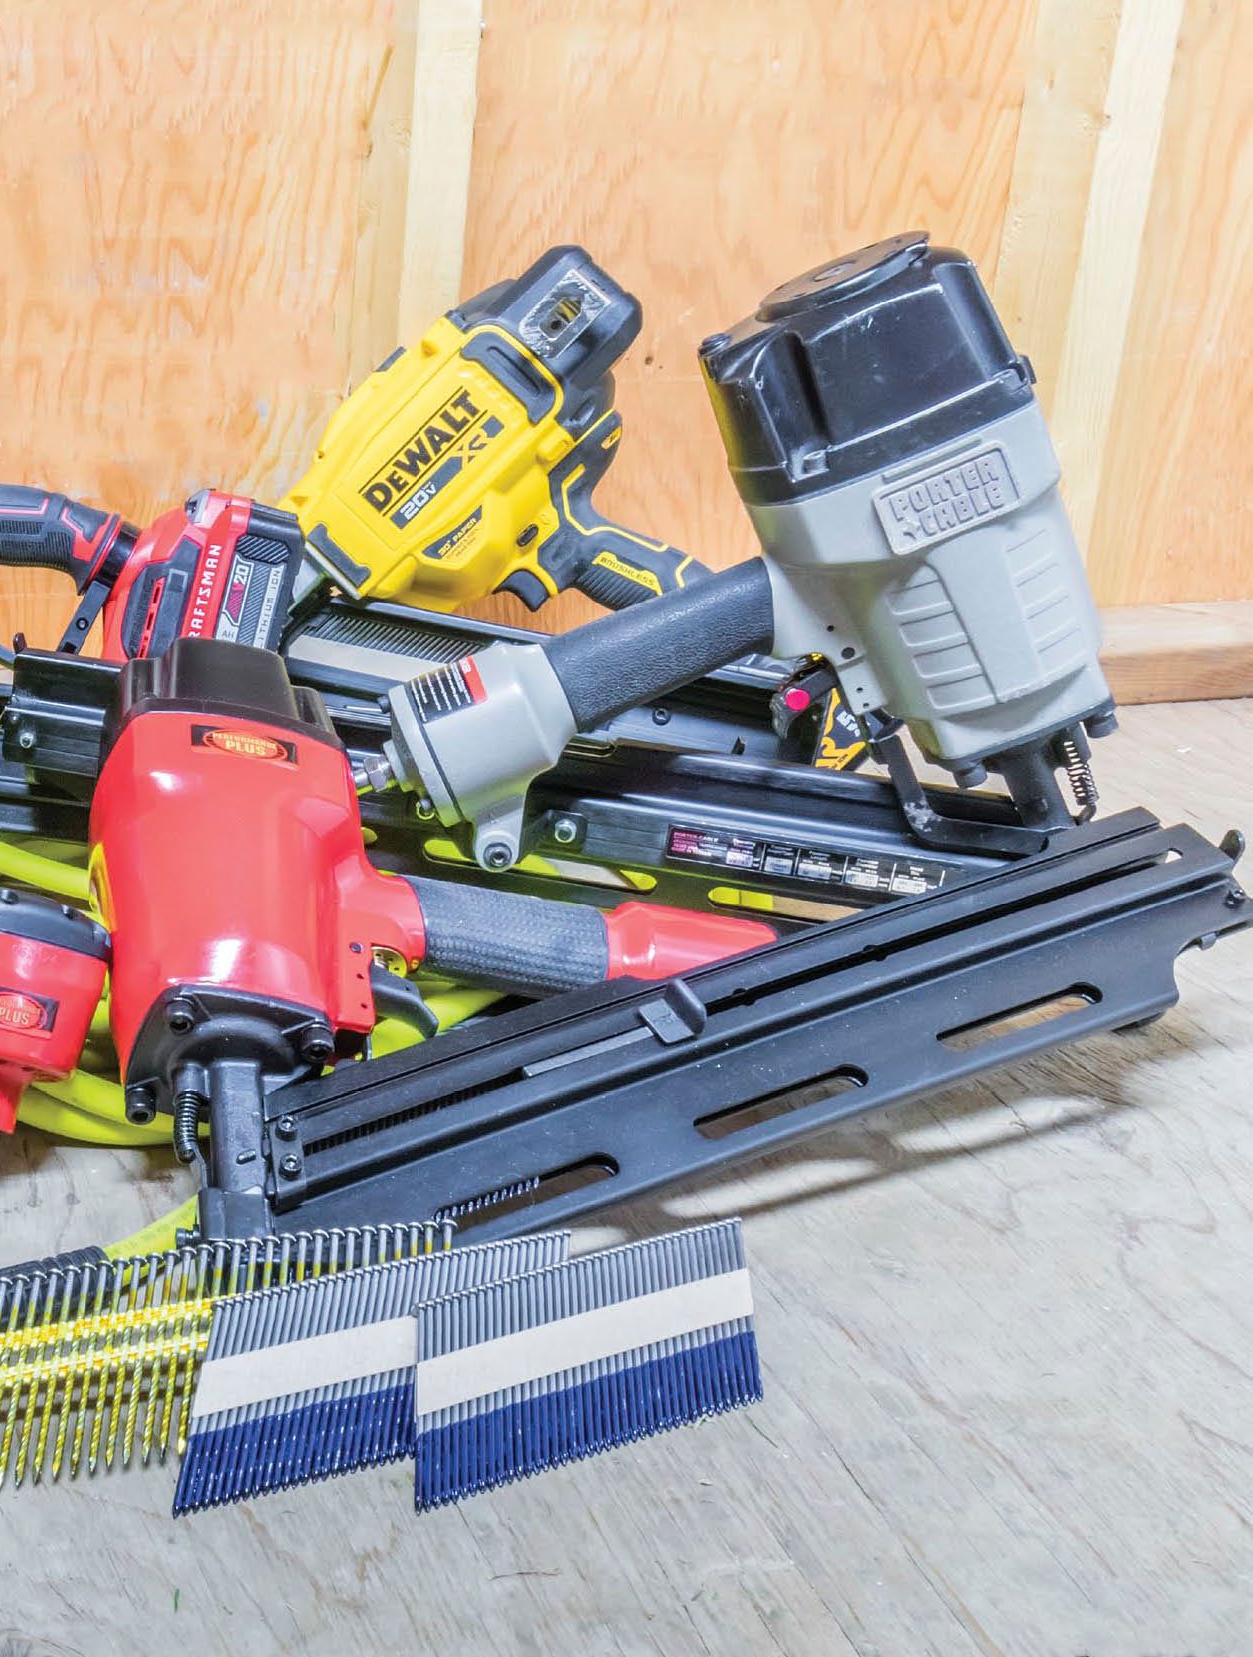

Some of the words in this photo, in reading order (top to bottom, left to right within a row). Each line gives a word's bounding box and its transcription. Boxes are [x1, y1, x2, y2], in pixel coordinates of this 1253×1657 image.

[889, 456, 999, 522] PORTER
[919, 480, 1005, 537] CABLE
[452, 517, 477, 542] PAPER
[188, 544, 223, 637] RAFTSMAN
[270, 569, 282, 590] ION
[225, 740, 266, 756] PLUS
